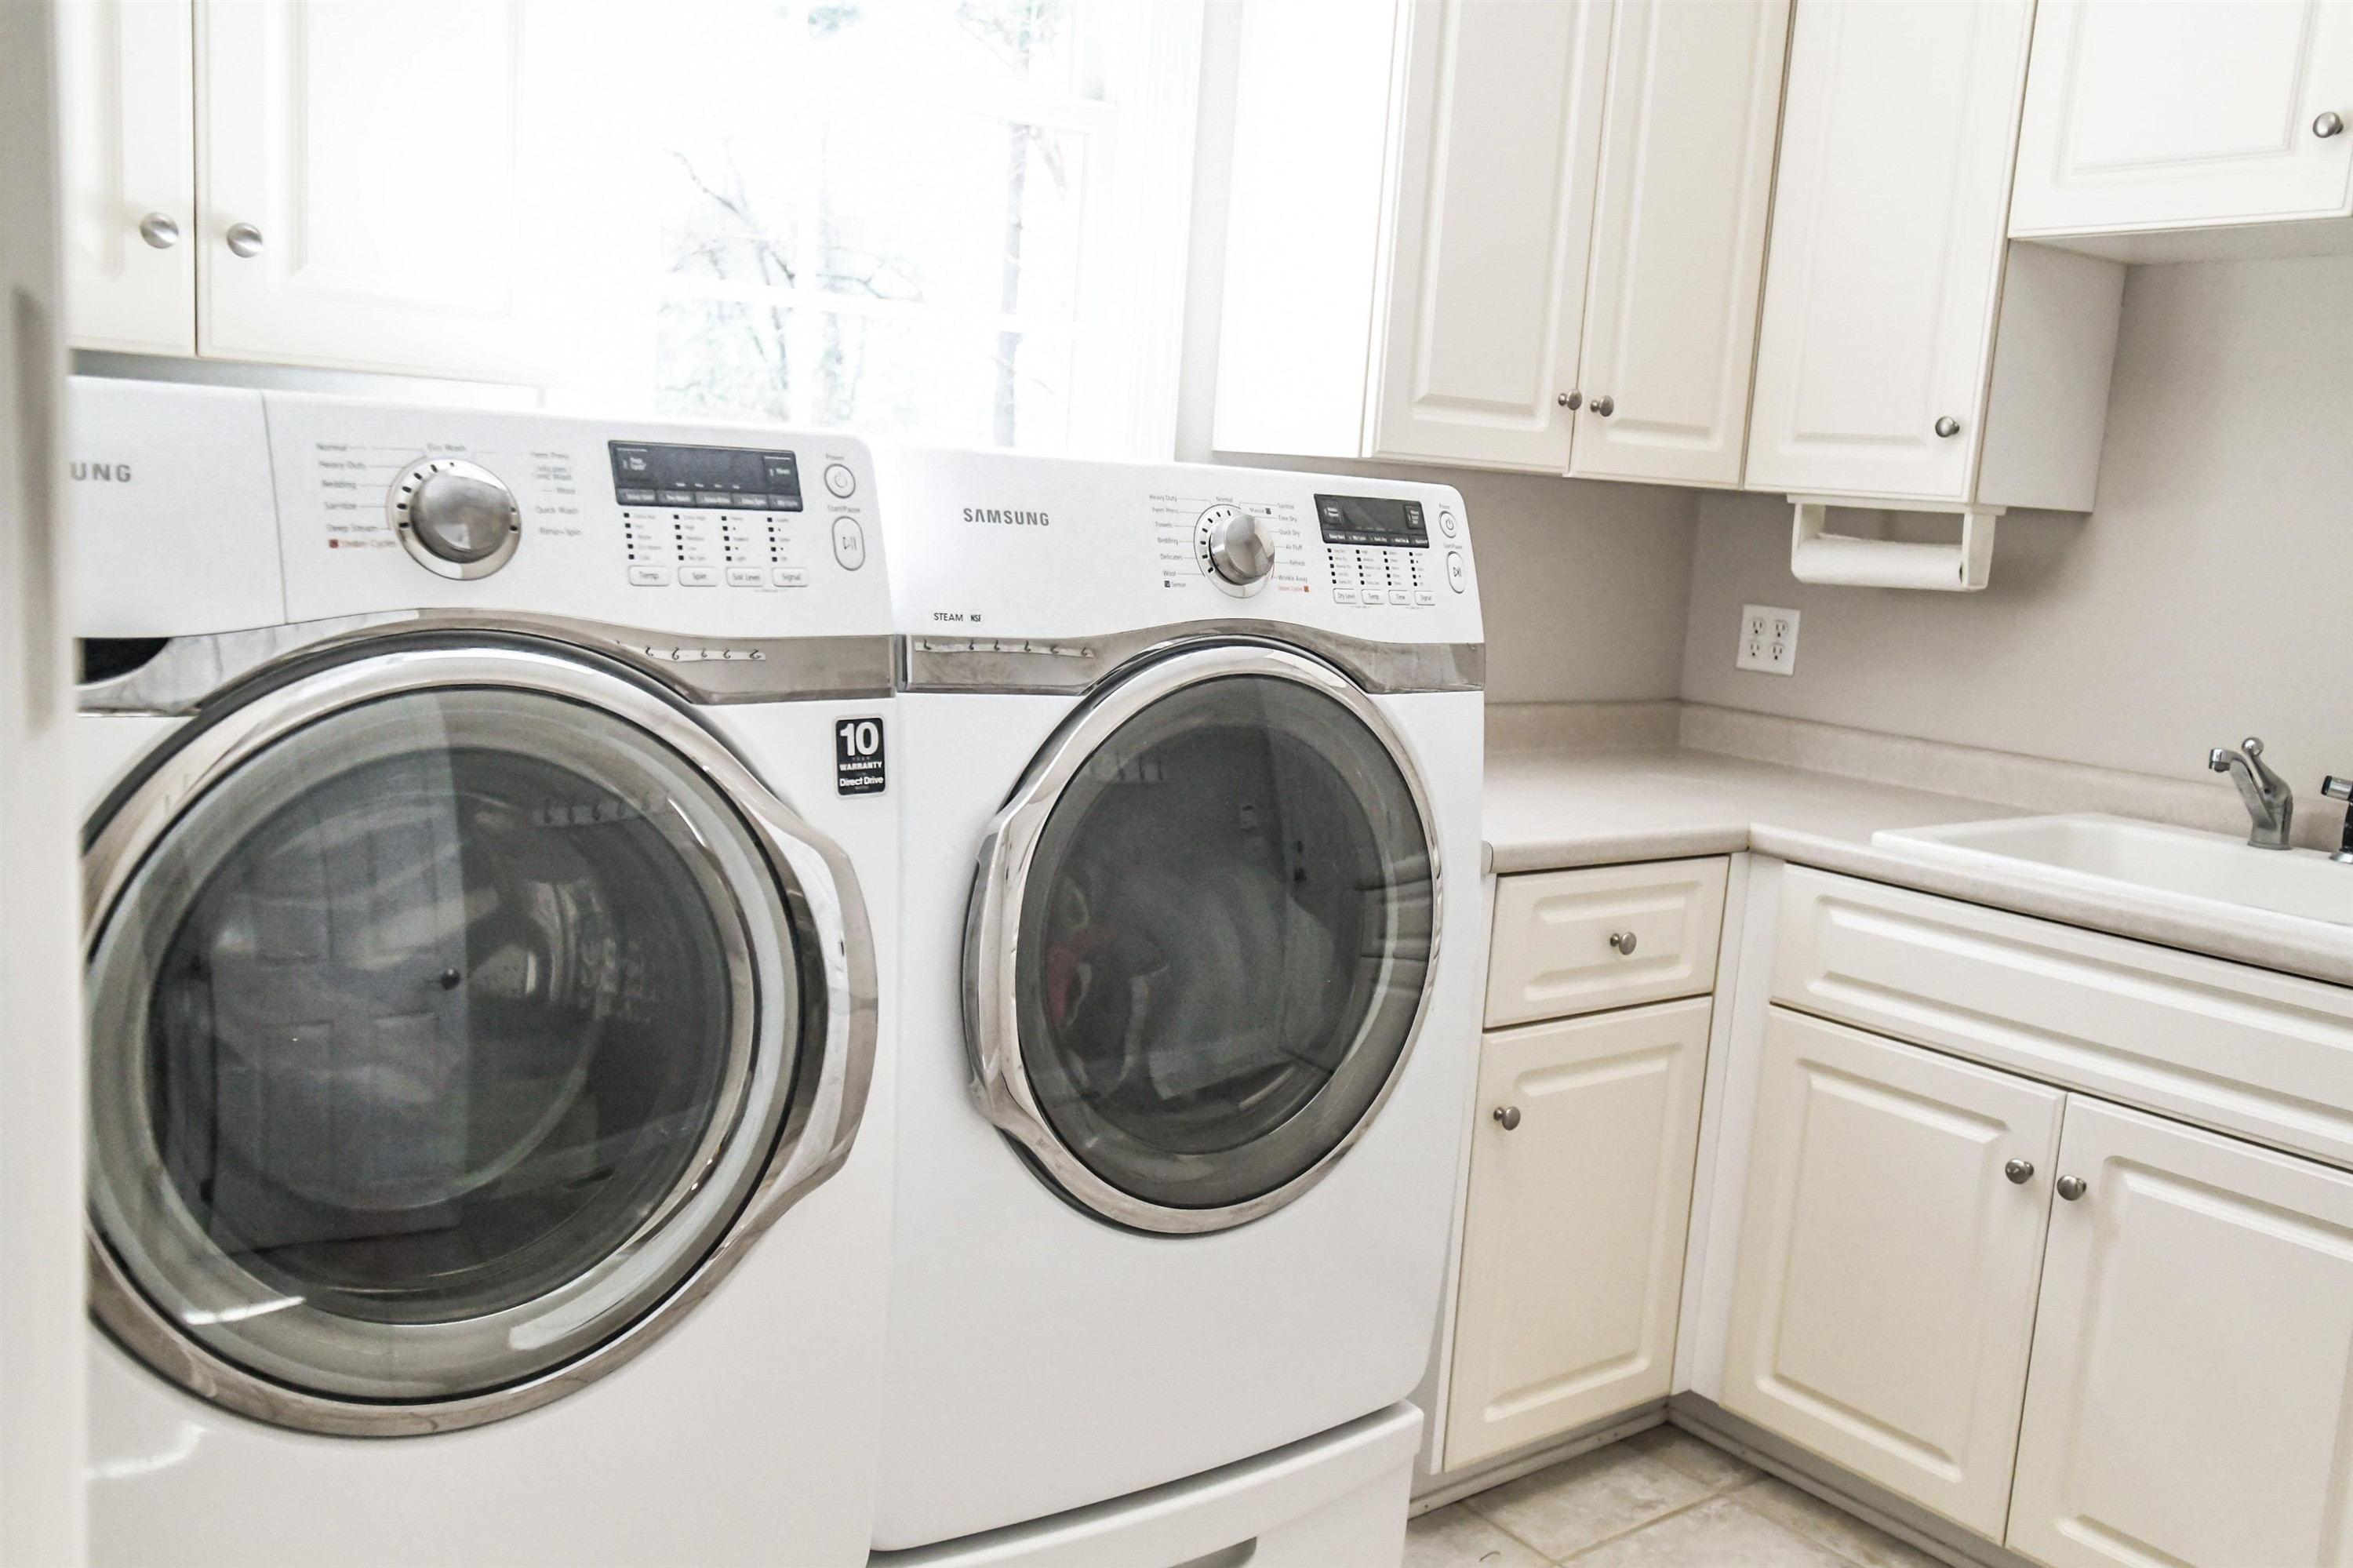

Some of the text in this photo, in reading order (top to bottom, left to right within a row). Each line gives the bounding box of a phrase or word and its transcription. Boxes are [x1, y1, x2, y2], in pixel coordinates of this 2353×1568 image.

[963, 508, 1049, 526] SAMSUNG
[1157, 537, 1178, 546] Bedding
[933, 613, 964, 622] STEAM
[839, 722, 879, 757] 10
[839, 762, 882, 772] WARRANTY
[839, 776, 885, 788] Direct Drive
